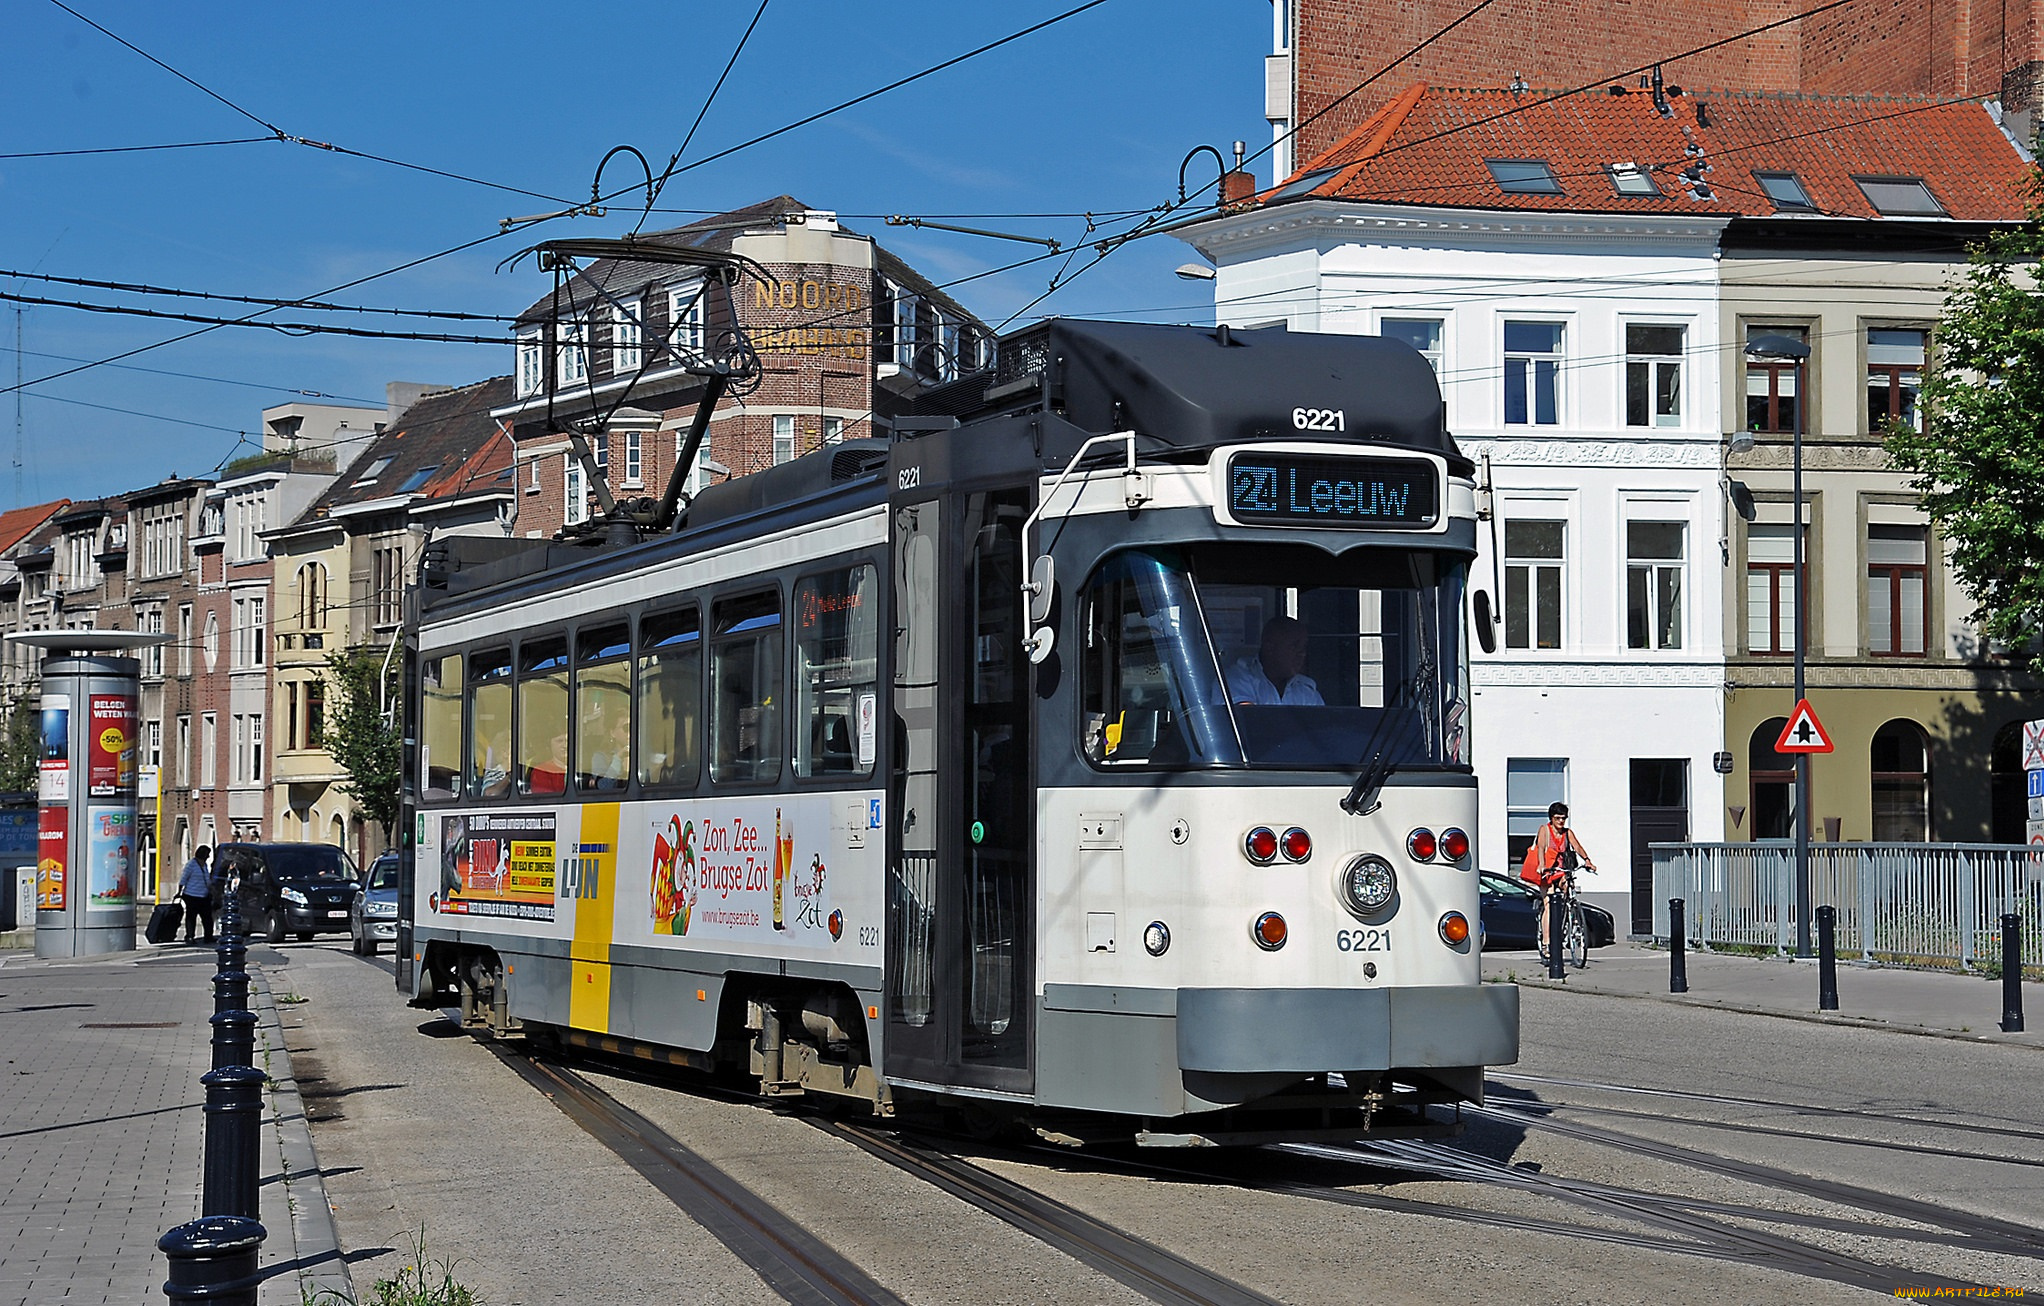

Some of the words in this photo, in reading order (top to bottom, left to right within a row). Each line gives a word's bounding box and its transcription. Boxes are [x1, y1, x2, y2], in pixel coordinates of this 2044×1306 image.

[755, 279, 861, 312] NOORD
[1292, 407, 1345, 432] 6221
[898, 466, 920, 490] 6221
[1235, 468, 1277, 511] 24
[1290, 467, 1409, 516] Leeuw
[93, 709, 123, 719] WETEN
[94, 700, 125, 709] BELGEN
[101, 735, 123, 744] -50%
[572, 843, 578, 853] DE
[702, 819, 731, 856] Zon,
[733, 818, 768, 852] Zee...
[473, 838, 497, 873] DINO
[700, 857, 743, 900] Brugse
[745, 856, 769, 892] Zot
[701, 908, 760, 930] www.brugsezot.be
[859, 927, 880, 946] 6221
[1337, 929, 1392, 952] 6221
